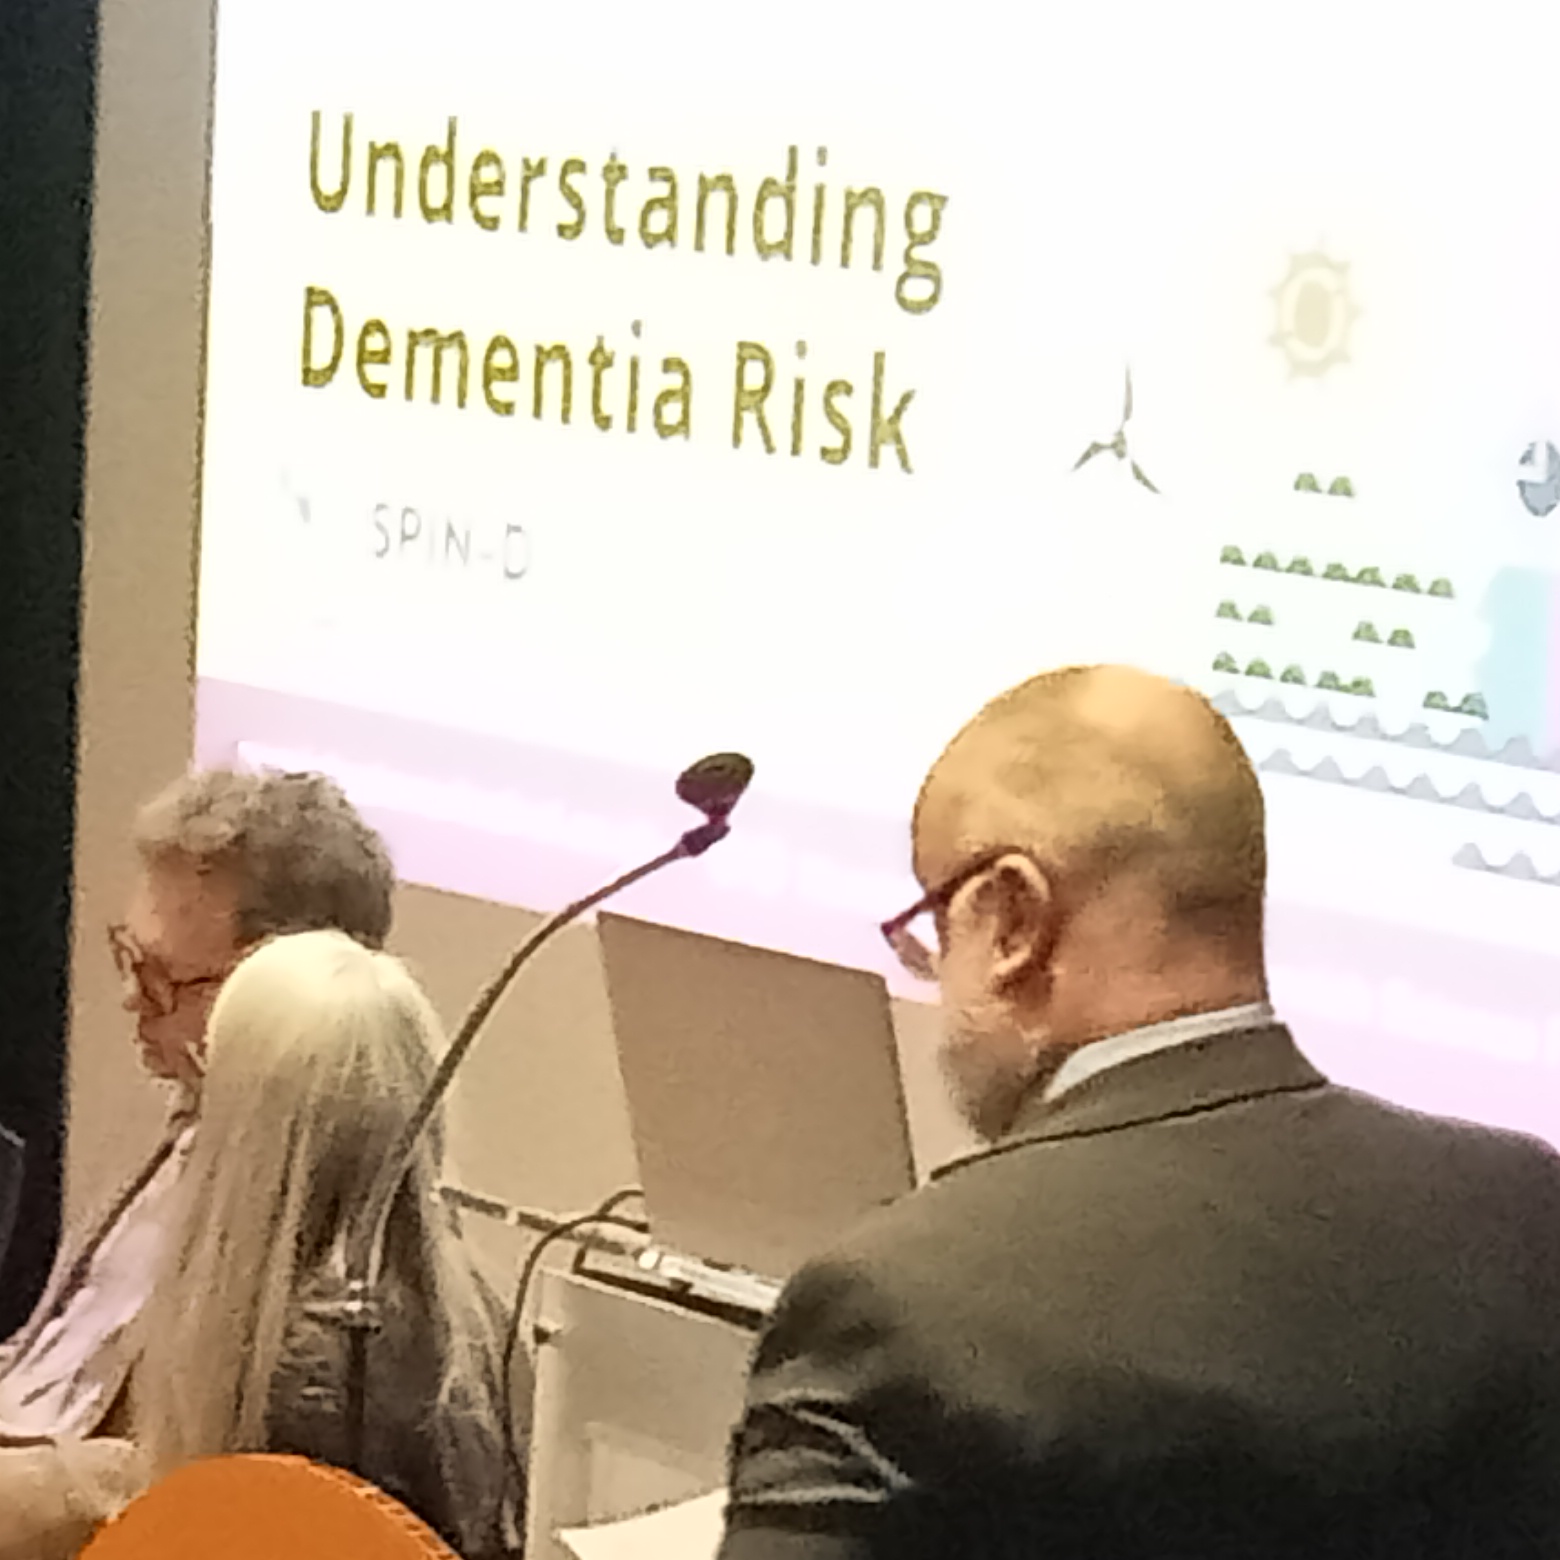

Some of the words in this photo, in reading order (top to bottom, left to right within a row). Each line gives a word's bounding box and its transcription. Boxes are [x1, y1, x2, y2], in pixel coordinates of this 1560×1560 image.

[307, 109, 950, 315] Understanding
[302, 284, 692, 441] Dementia
[731, 340, 915, 475] Risk
[372, 501, 532, 581] SPIN-D
